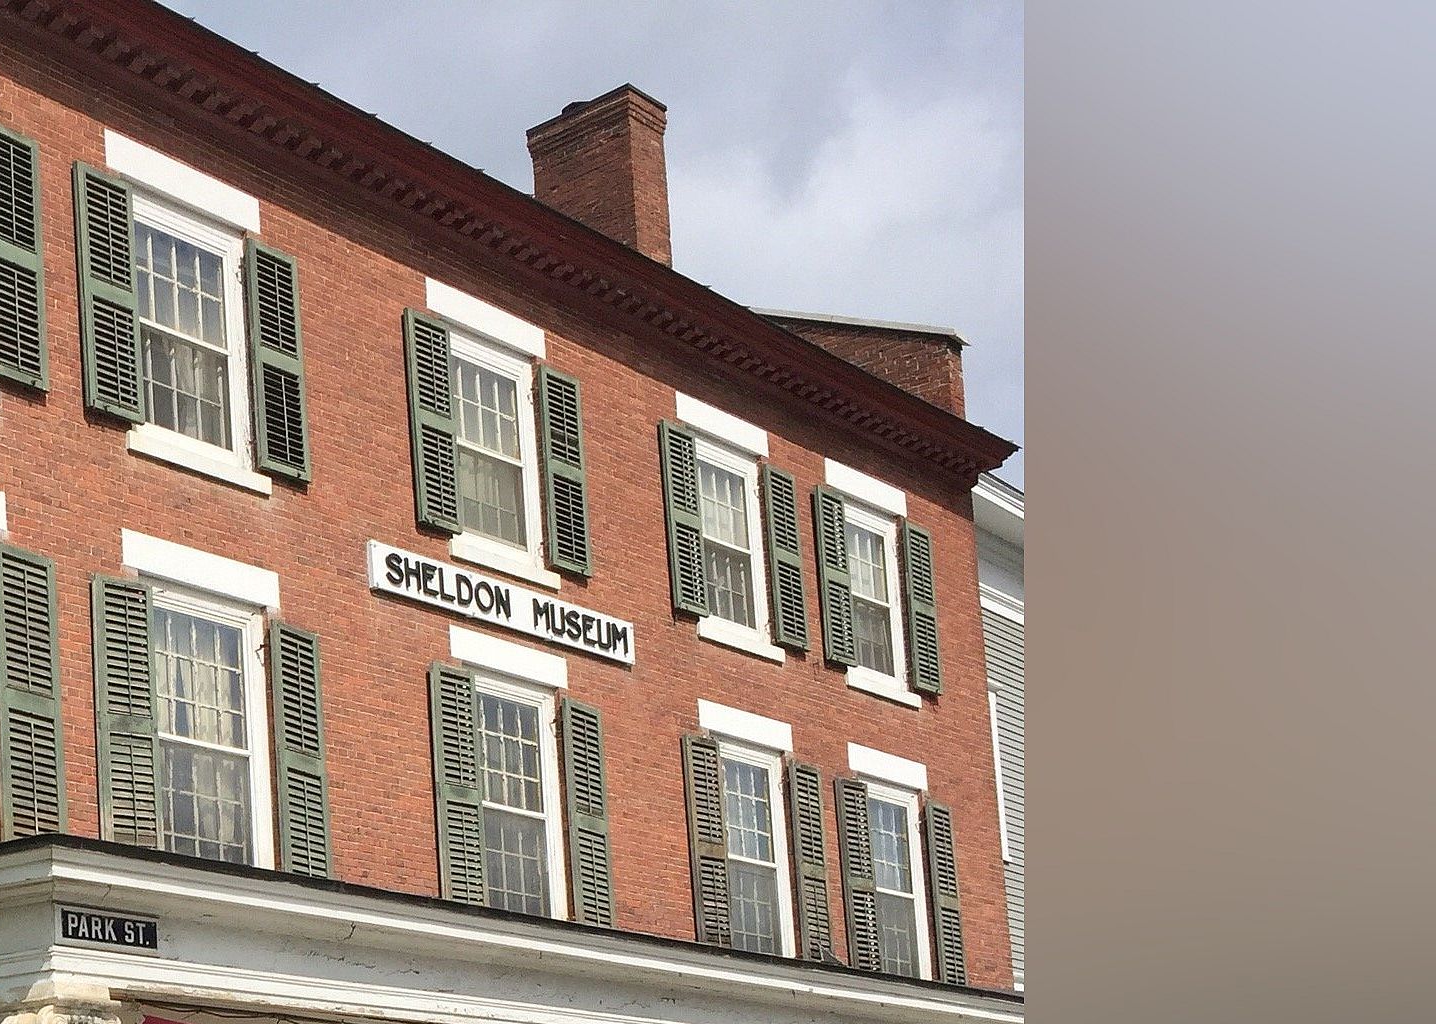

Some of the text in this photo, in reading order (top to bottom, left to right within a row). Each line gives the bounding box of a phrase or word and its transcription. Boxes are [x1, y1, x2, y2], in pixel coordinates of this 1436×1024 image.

[385, 552, 629, 658] SHELDON MUSEUM
[67, 913, 150, 945] PARK ST.
